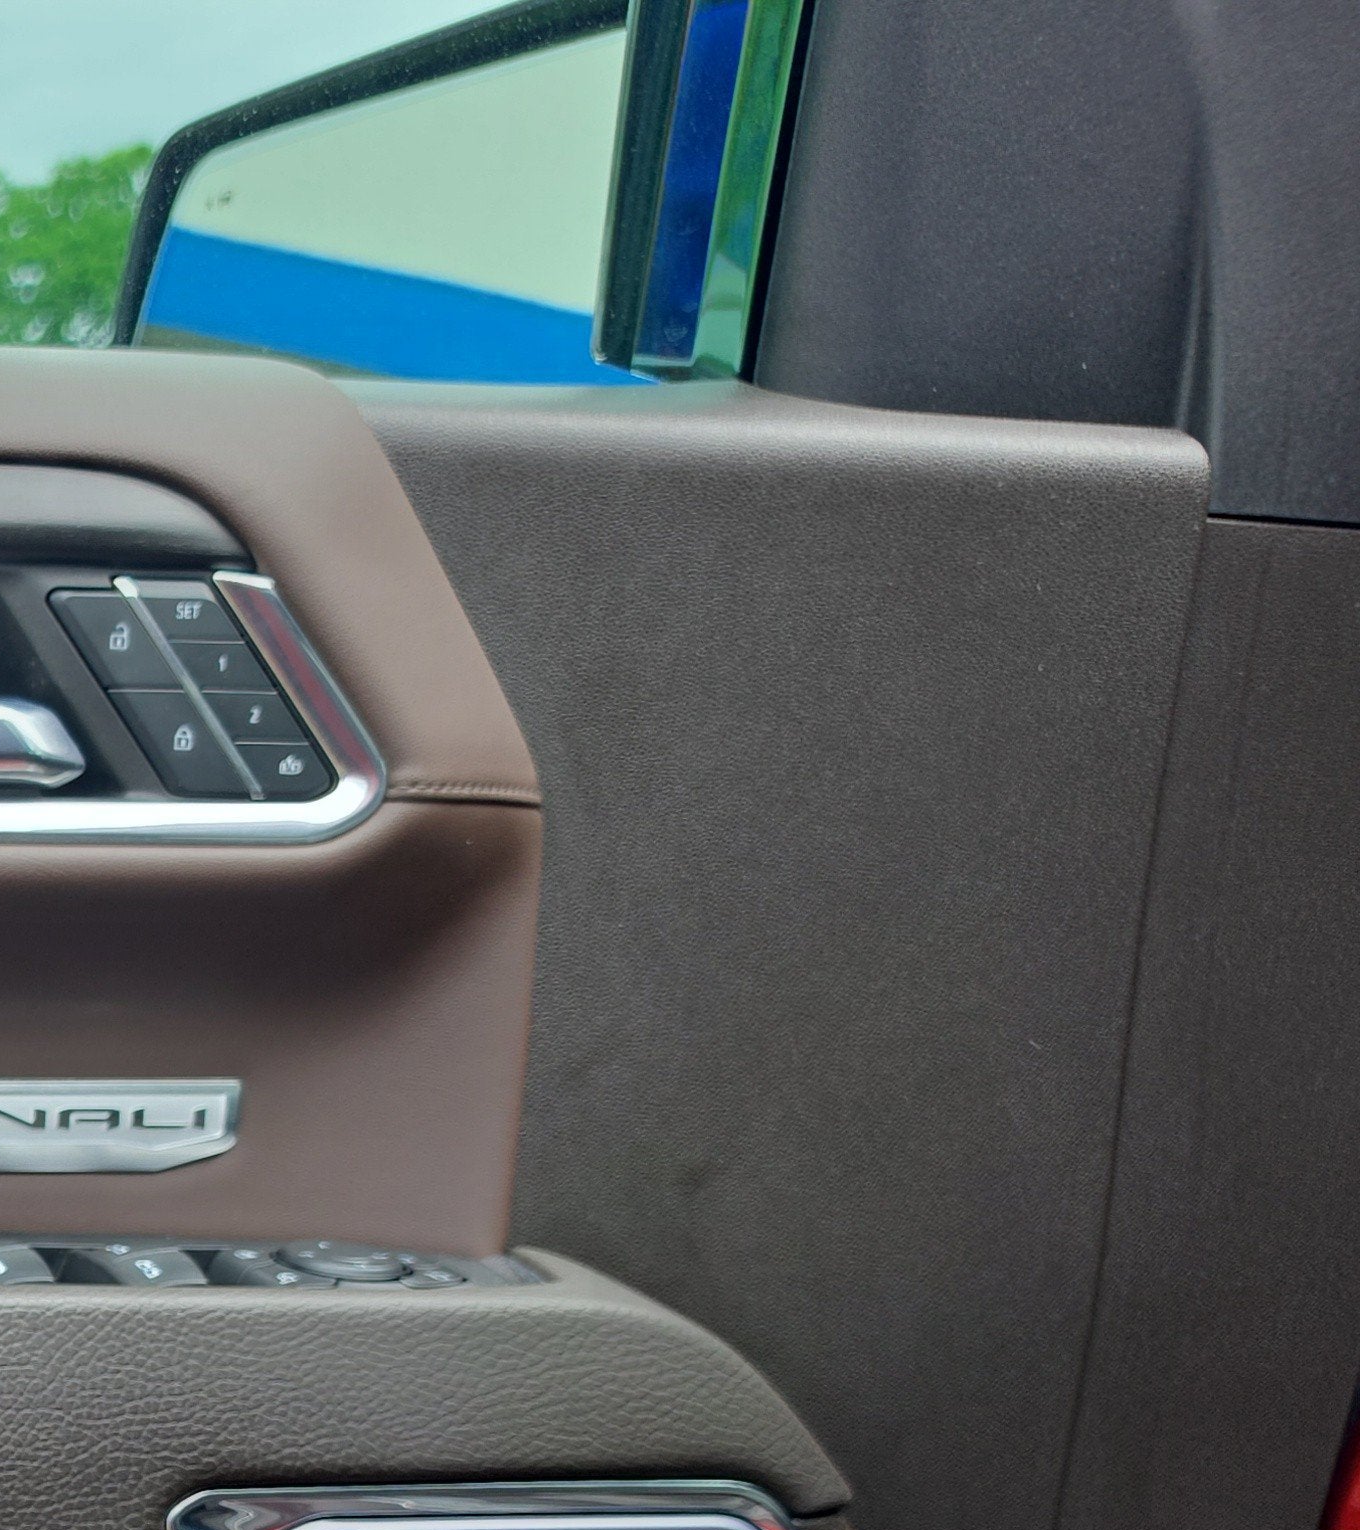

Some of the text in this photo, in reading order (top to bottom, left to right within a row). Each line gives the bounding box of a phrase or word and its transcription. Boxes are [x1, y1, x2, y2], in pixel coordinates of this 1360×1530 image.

[175, 601, 203, 620] SET
[218, 654, 228, 672] 1
[249, 705, 262, 724] 2
